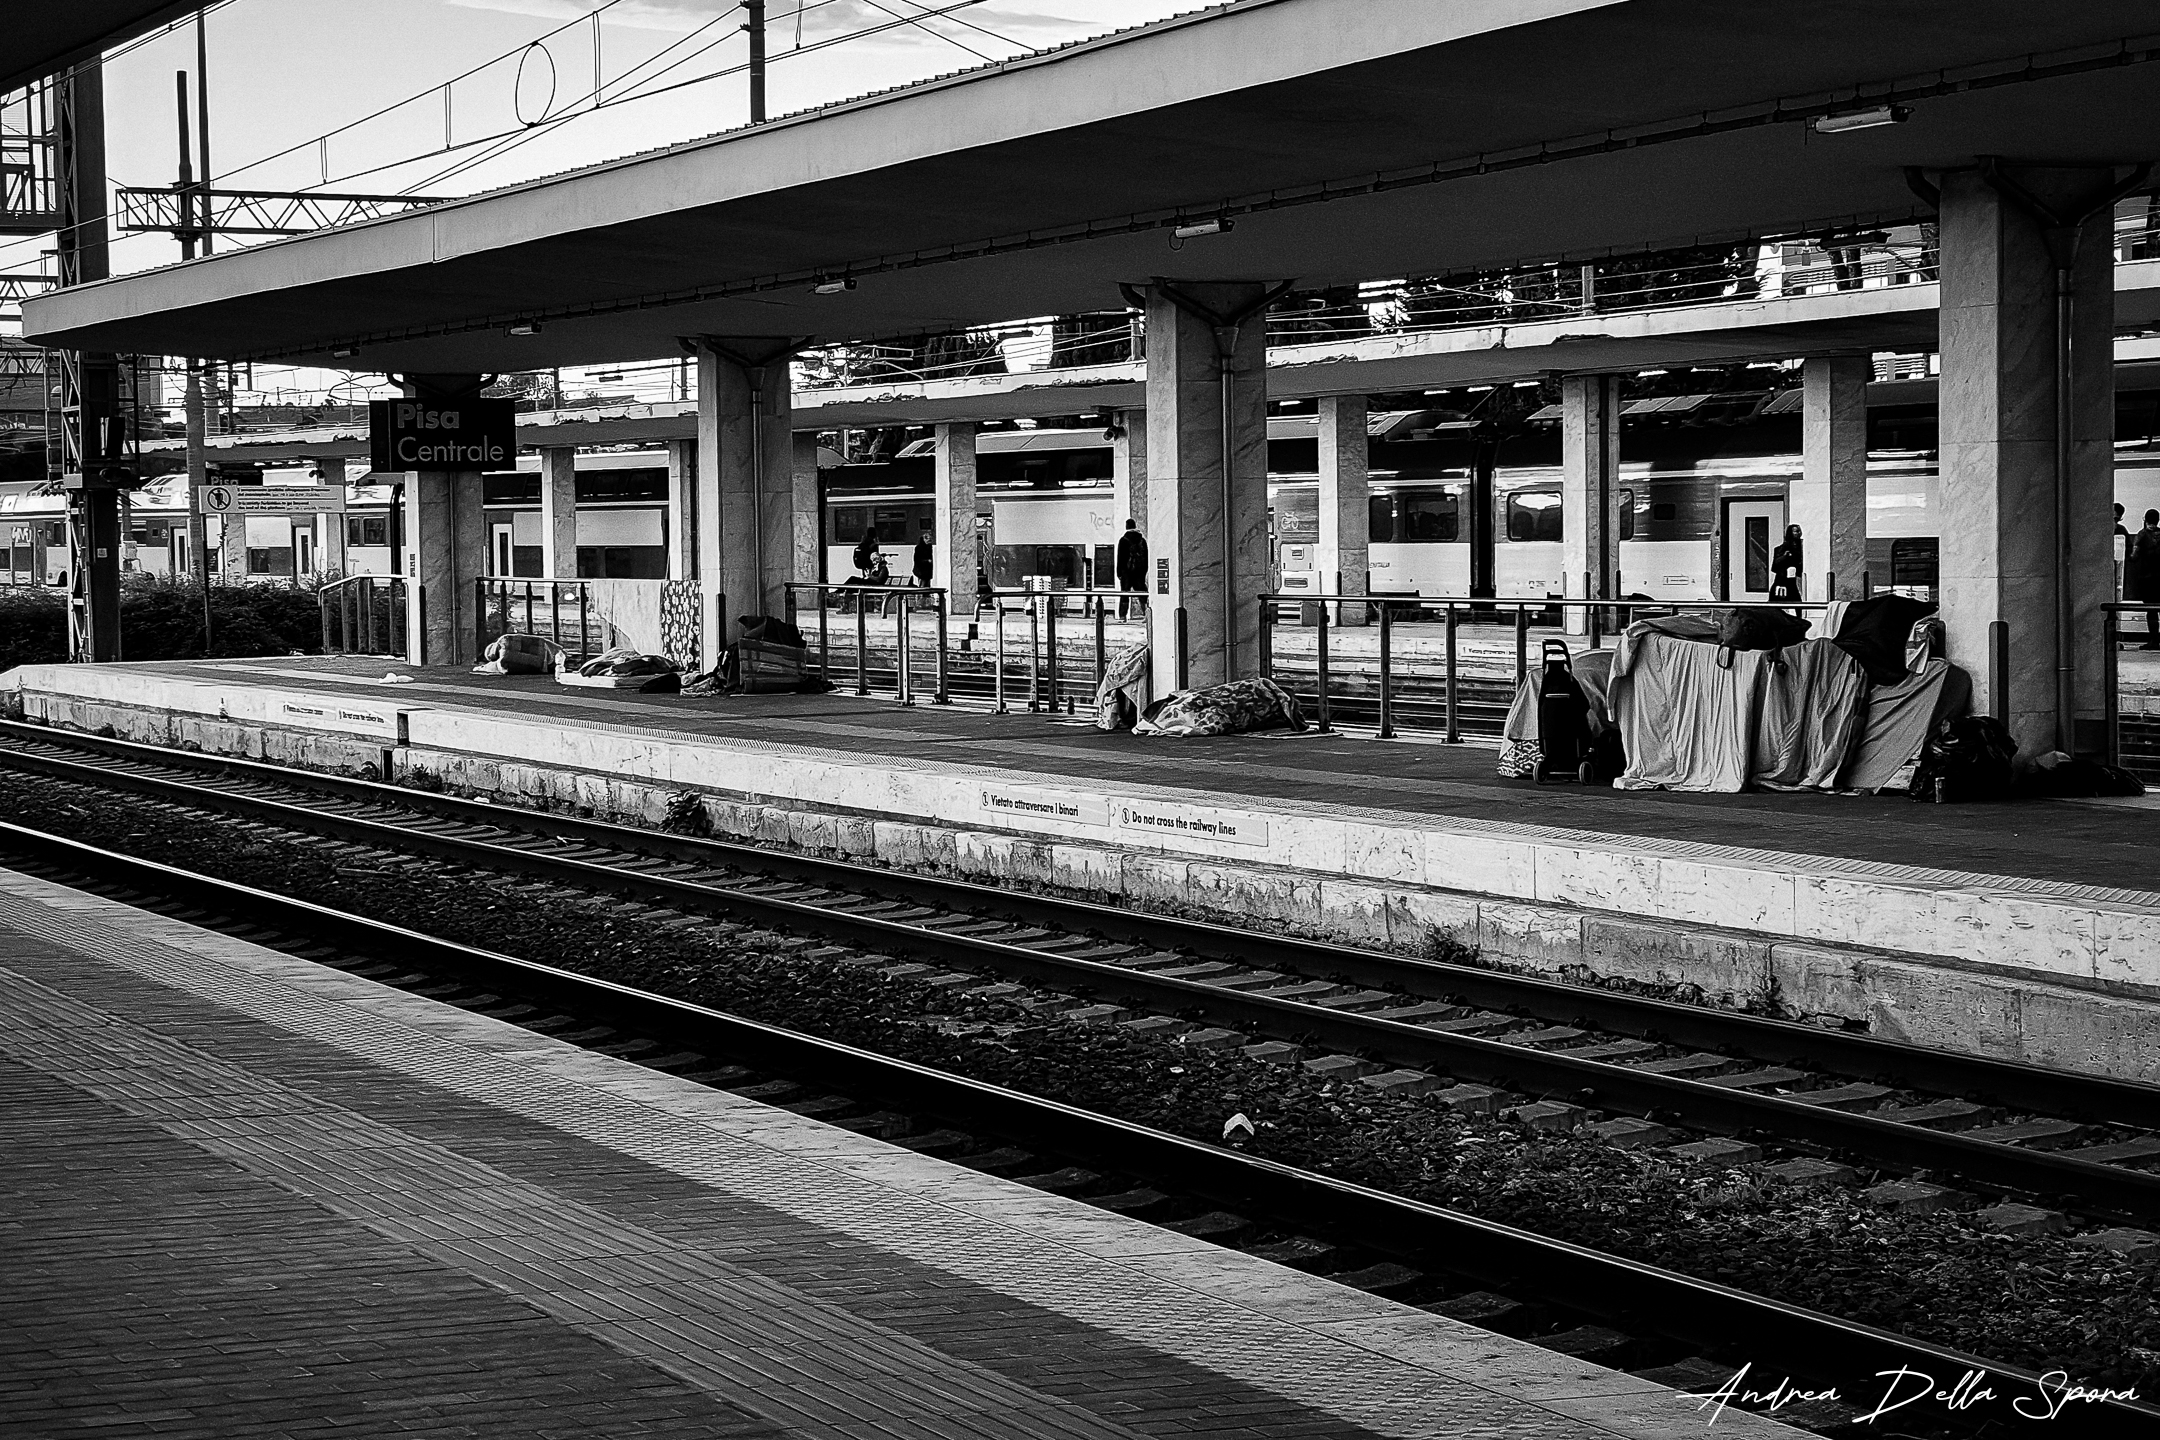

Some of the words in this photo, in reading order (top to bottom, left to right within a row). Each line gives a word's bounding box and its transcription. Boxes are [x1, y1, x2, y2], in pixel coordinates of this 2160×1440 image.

[397, 403, 460, 429] Pisa
[397, 435, 504, 462] Centrale
[991, 794, 1014, 808] Vietato
[1014, 799, 1054, 814] attraversare
[1058, 802, 1079, 817] binari
[1132, 811, 1142, 824] Do
[1143, 815, 1155, 826] not
[1156, 817, 1175, 828] cross
[1176, 816, 1188, 830] the
[1189, 819, 1217, 836] railway
[1218, 821, 1236, 836] lines
